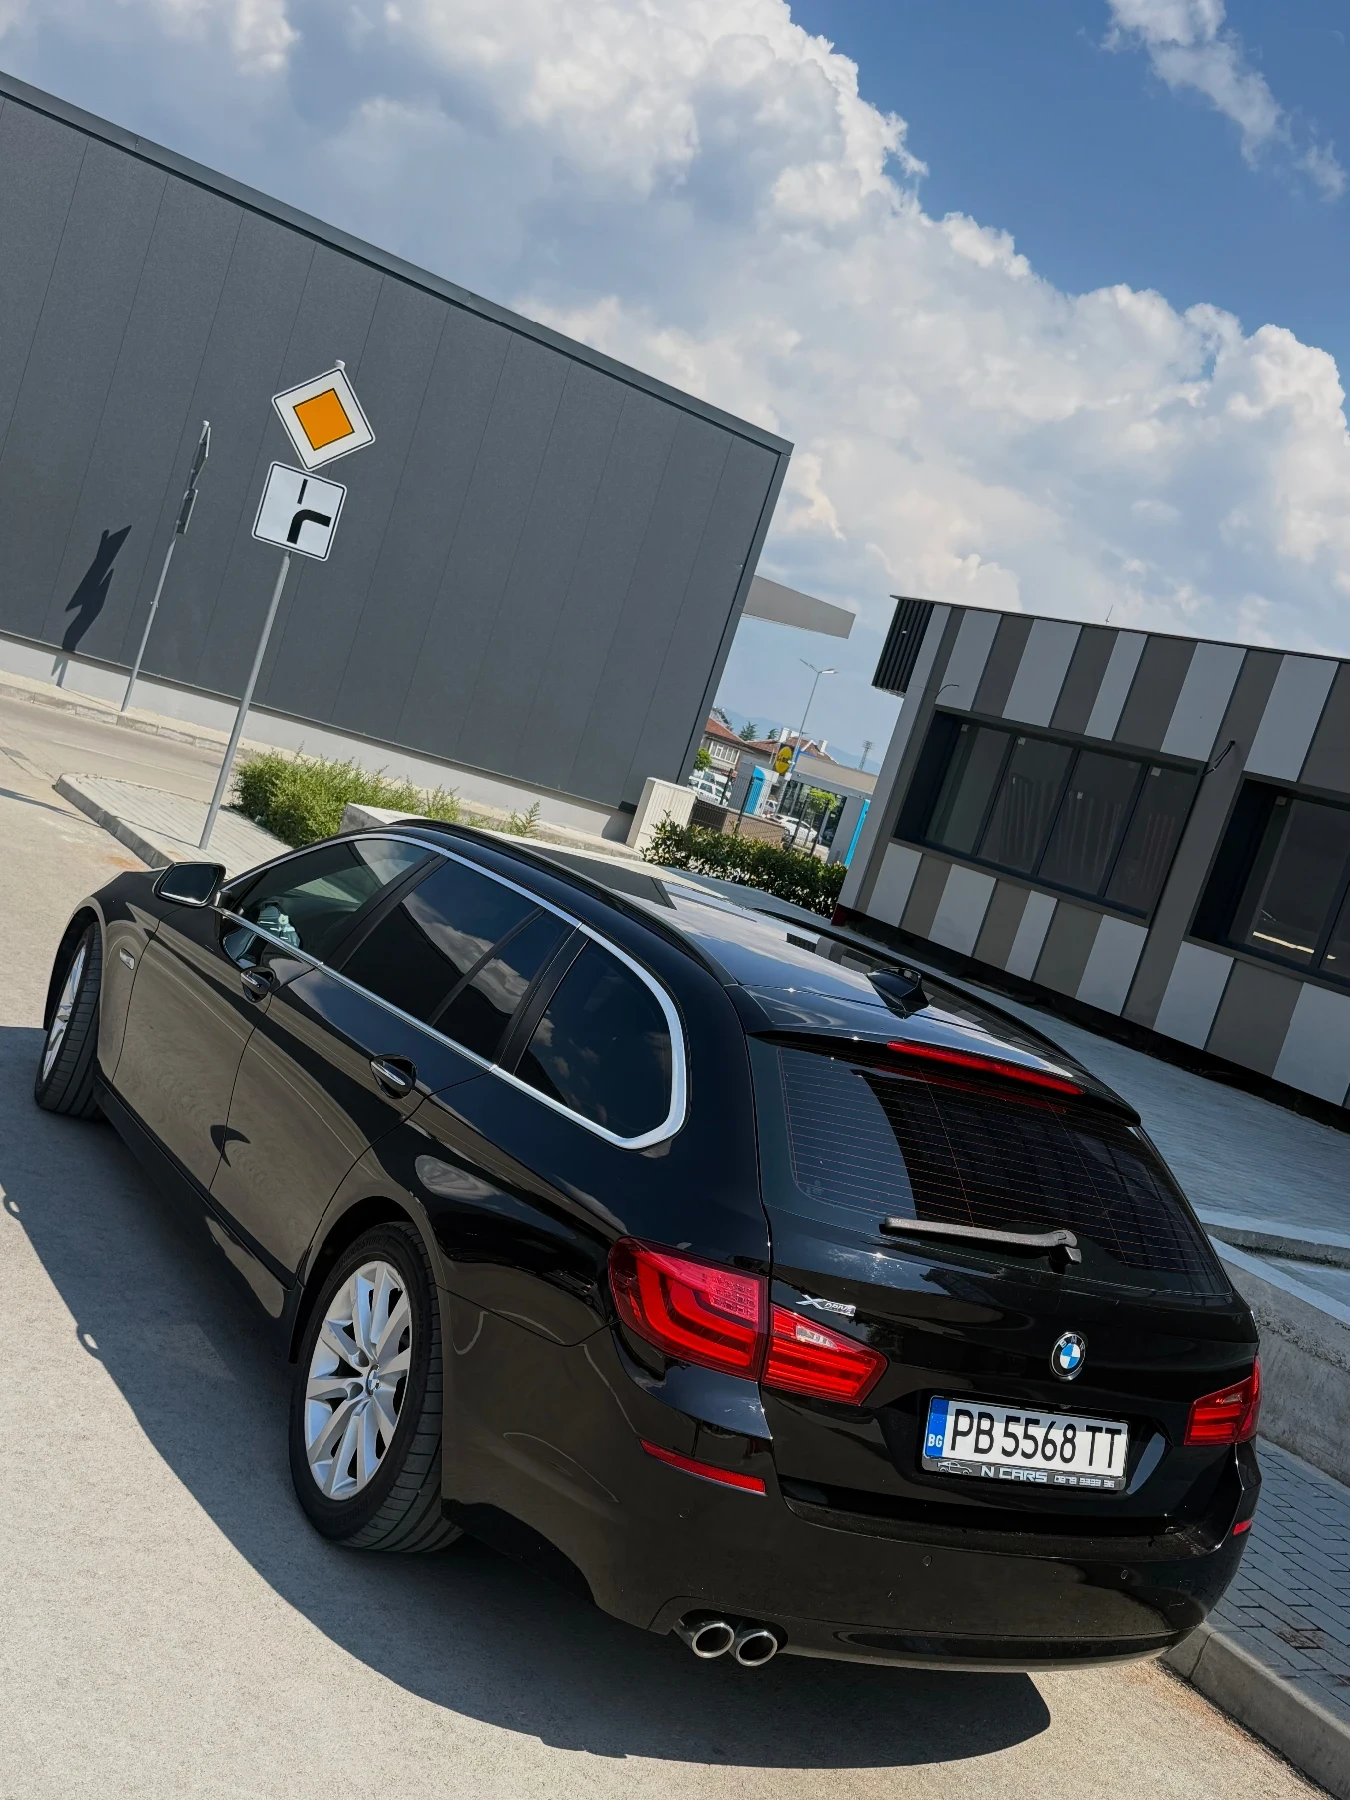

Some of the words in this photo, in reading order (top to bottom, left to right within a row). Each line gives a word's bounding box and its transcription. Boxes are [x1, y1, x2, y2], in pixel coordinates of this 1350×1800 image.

[928, 1434, 943, 1448] BG
[980, 1465, 995, 1478] N
[999, 1467, 1048, 1483] CARS
